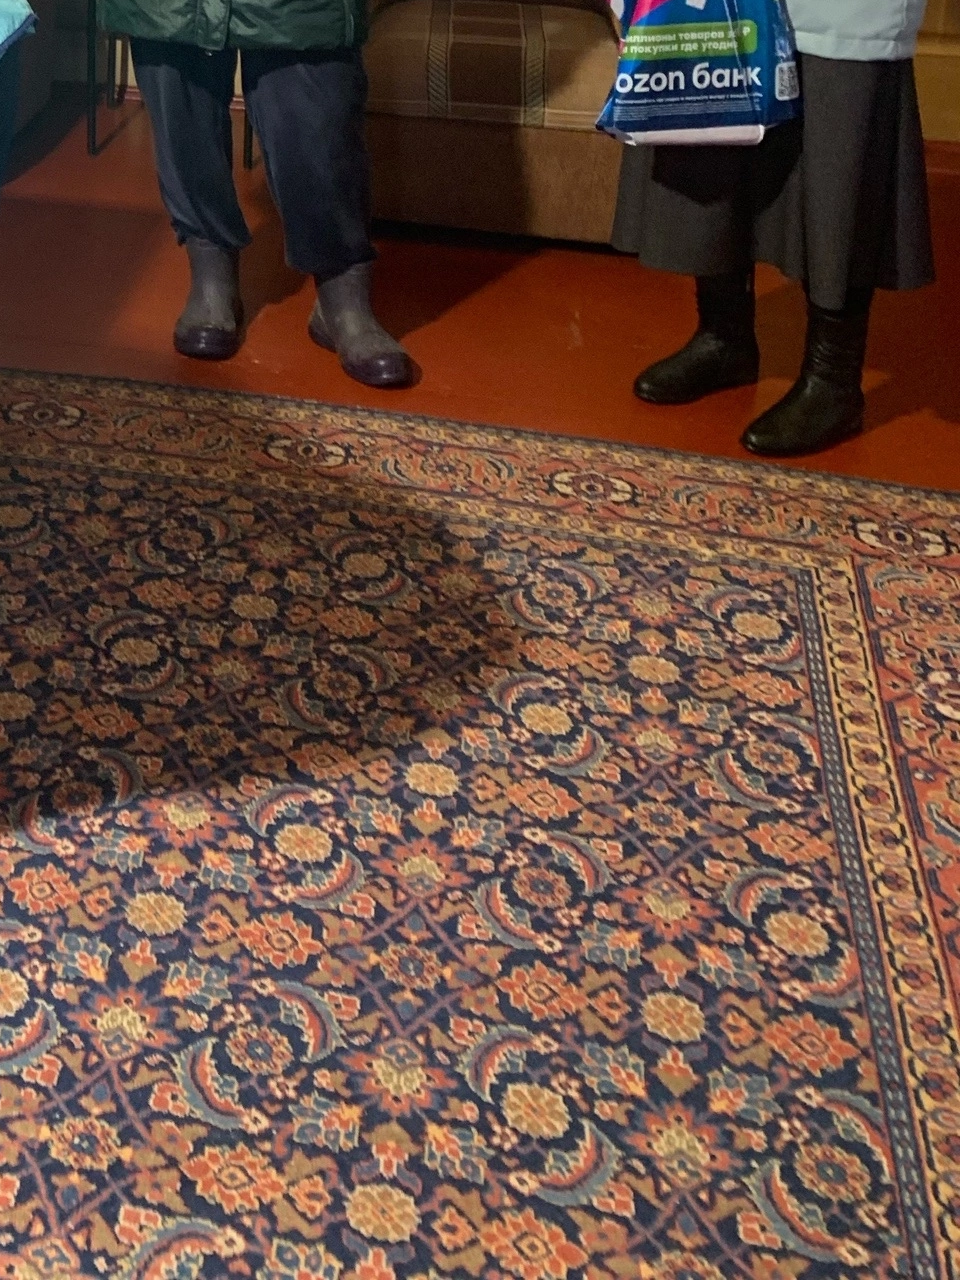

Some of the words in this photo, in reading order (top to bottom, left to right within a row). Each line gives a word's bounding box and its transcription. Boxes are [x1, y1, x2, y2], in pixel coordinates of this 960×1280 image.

[678, 30, 725, 42] товаров
[630, 44, 678, 55] покупки
[680, 42, 699, 52] где
[615, 68, 685, 94] ozon
[692, 62, 762, 90] банк
